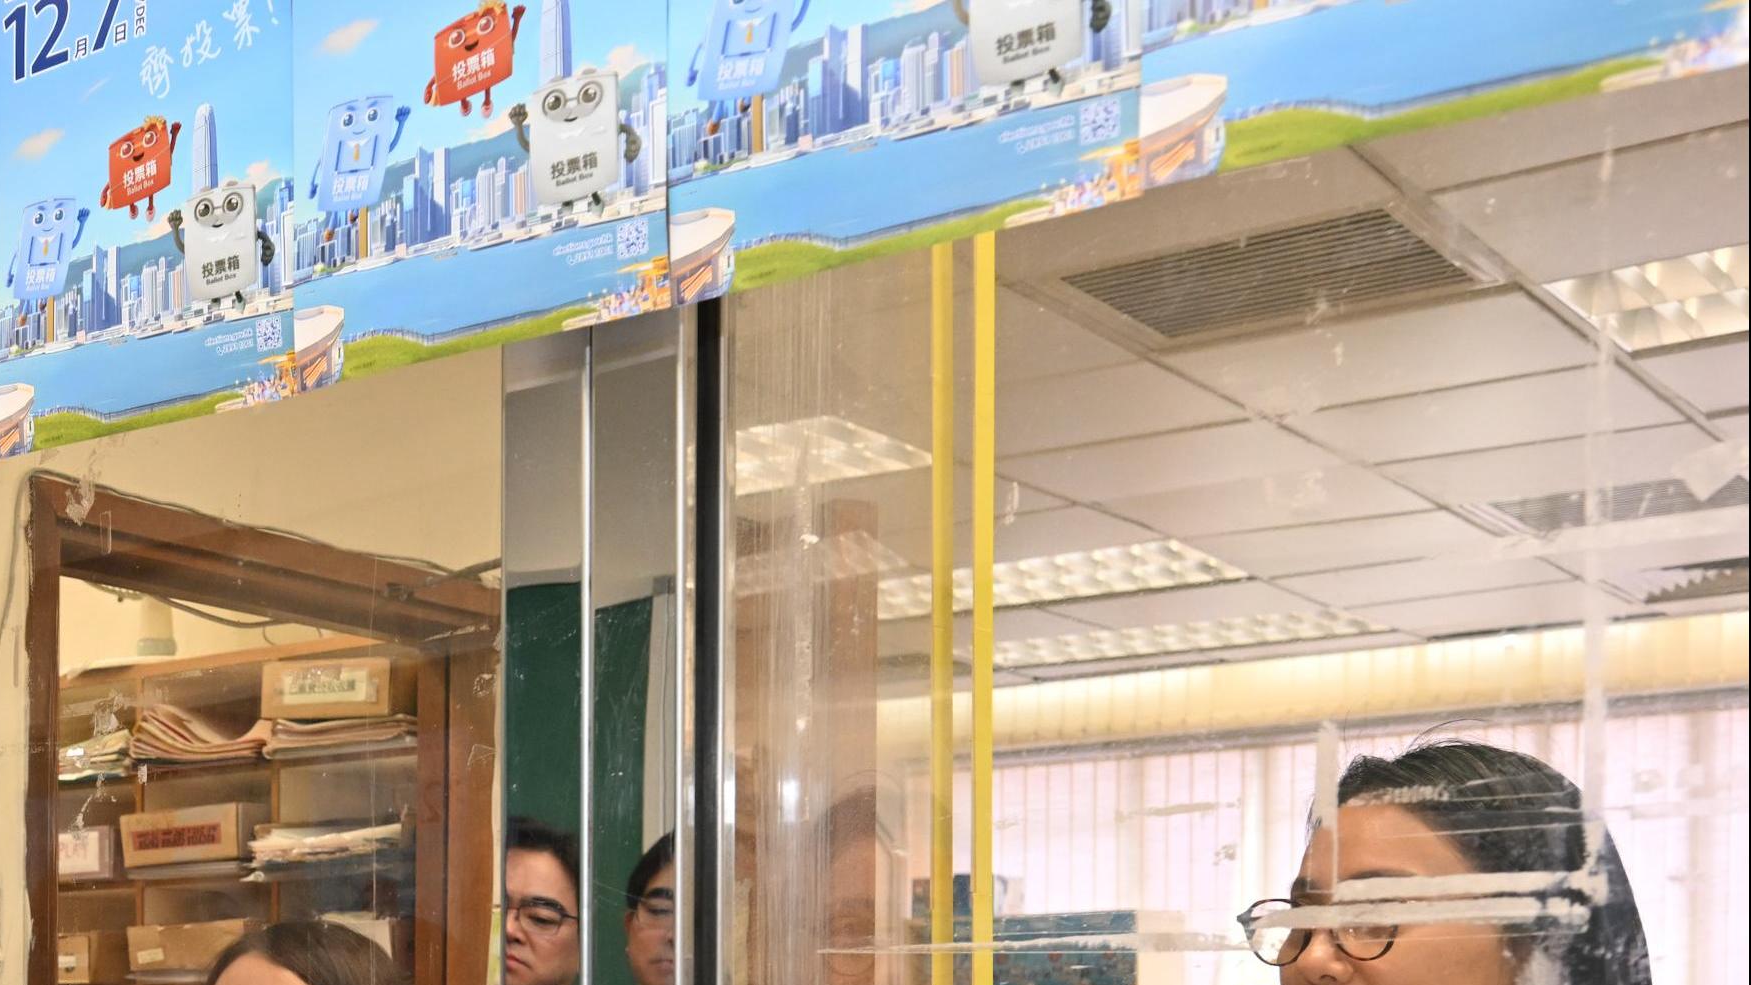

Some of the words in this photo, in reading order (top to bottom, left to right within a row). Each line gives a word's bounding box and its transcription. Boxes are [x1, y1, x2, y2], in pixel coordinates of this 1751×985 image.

[135, 5, 145, 36] DEC
[996, 22, 1057, 55] 投票箱
[453, 48, 495, 81] 投票箱
[717, 59, 764, 80] 投票箱
[457, 75, 474, 89] Ballot
[477, 70, 491, 82] Box
[123, 160, 157, 187] 投票箱
[551, 152, 598, 179] 投票箱
[127, 182, 141, 194] Ballot
[142, 179, 153, 189] Box
[556, 176, 573, 188] Ballot
[576, 172, 593, 183] Box
[25, 269, 55, 283] 投票箱
[202, 255, 240, 278] 投票箱
[206, 276, 220, 286] Ballot
[222, 273, 236, 282] Box
